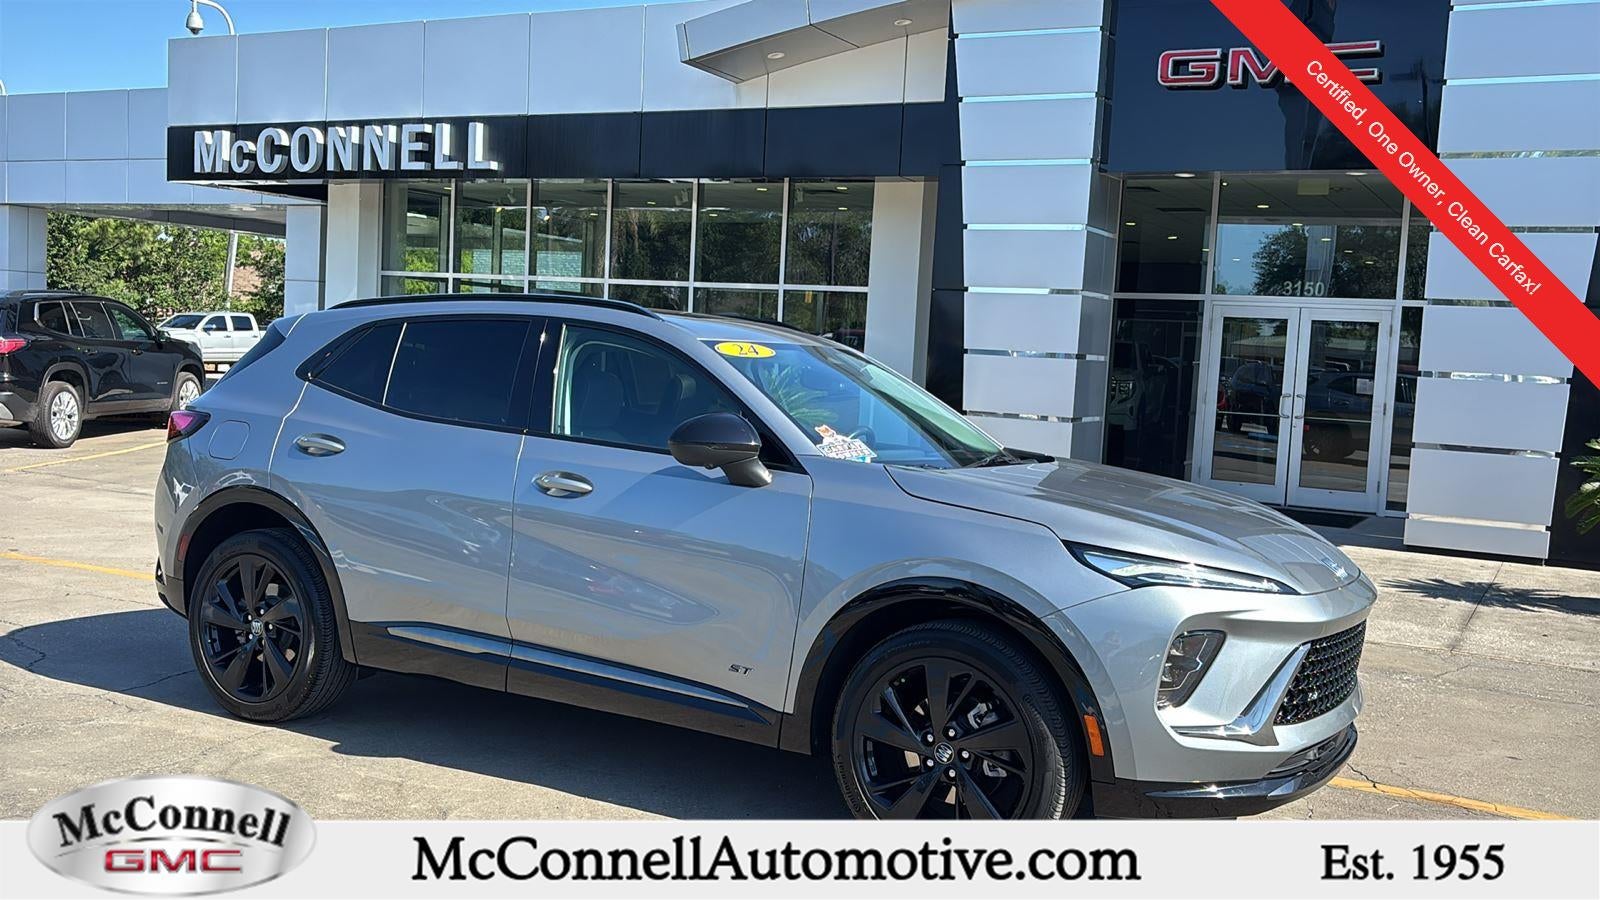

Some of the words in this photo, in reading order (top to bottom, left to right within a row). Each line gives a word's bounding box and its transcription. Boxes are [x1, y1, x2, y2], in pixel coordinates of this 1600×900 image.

[193, 121, 500, 174] McCONNELL
[1283, 280, 1325, 296] 3150
[732, 343, 760, 356] 24
[729, 663, 754, 675] ST
